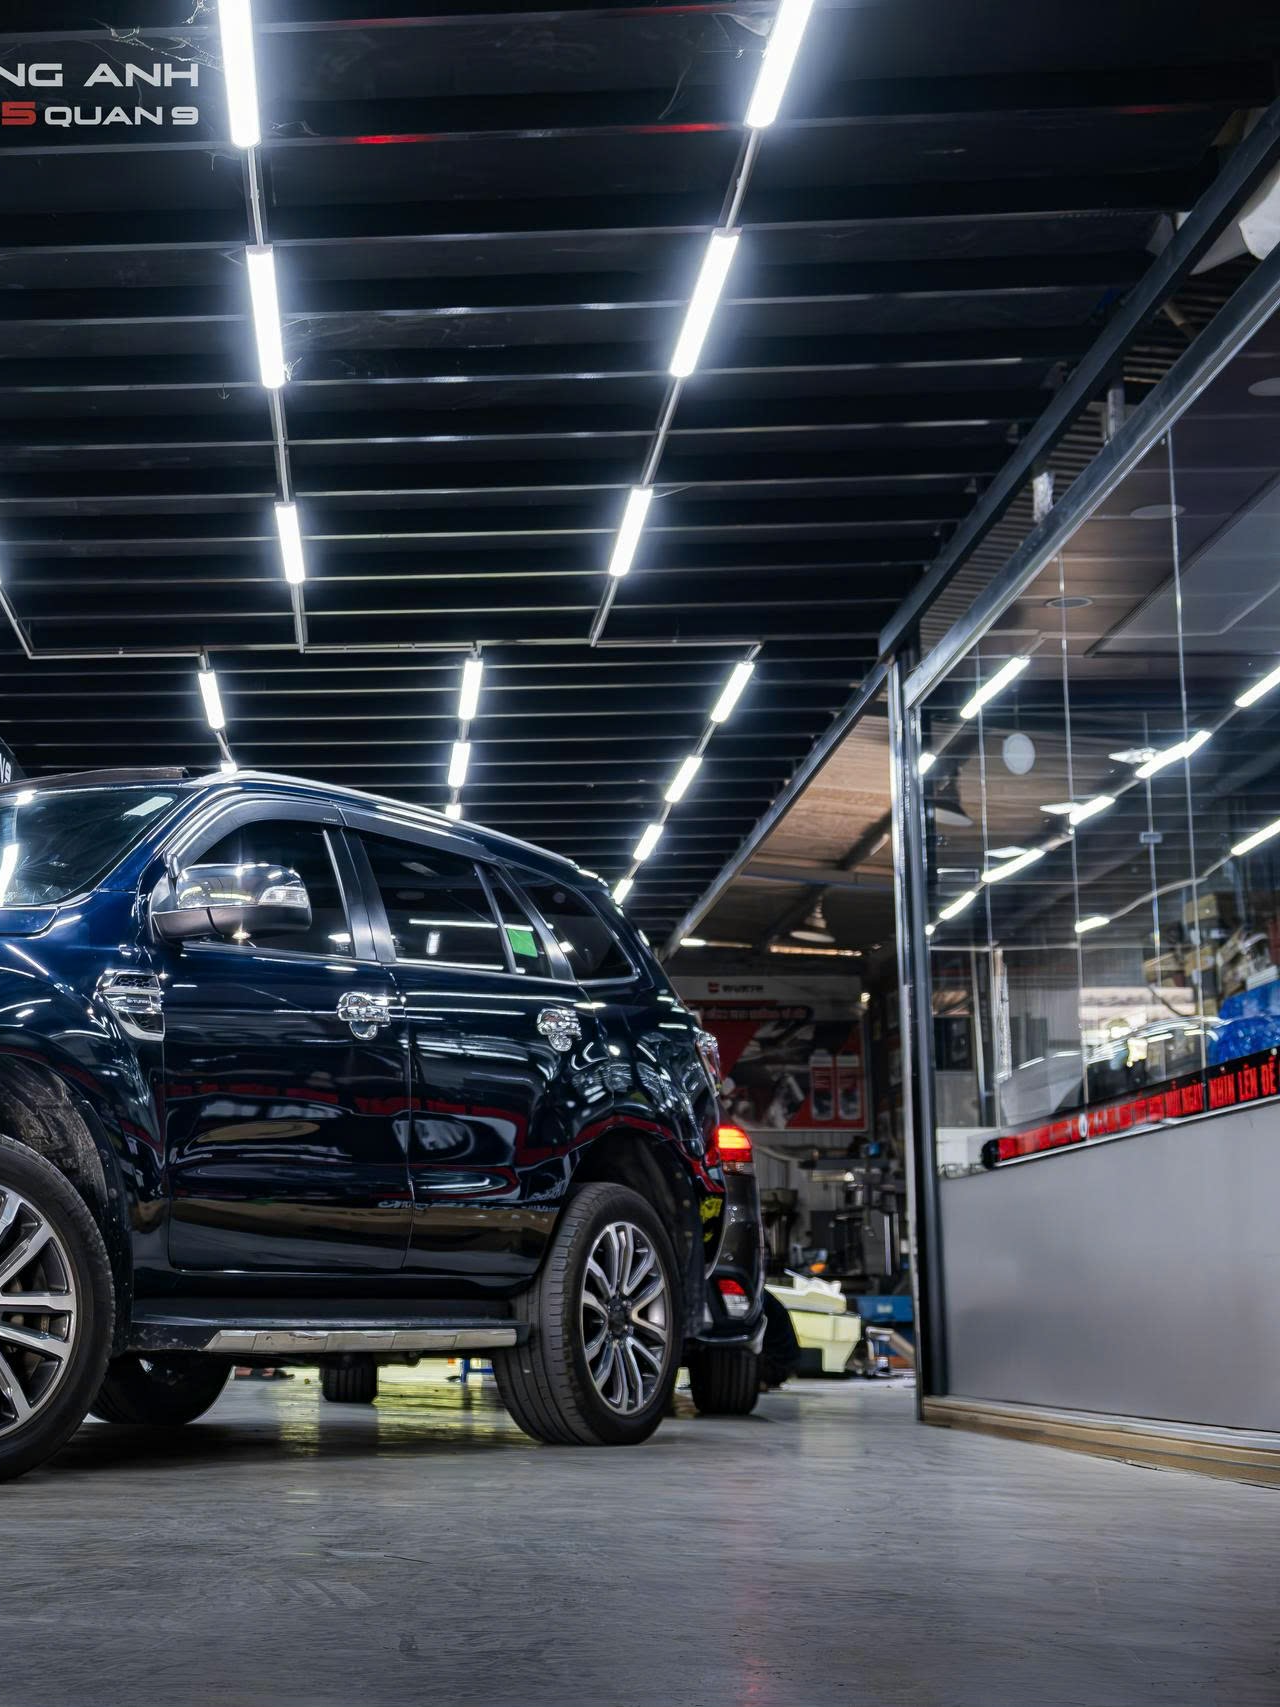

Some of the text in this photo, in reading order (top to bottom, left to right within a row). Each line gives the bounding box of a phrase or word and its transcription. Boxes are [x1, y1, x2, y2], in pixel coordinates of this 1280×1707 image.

[83, 63, 199, 87] ANH
[44, 106, 163, 128] QUAN
[171, 106, 199, 126] 9
